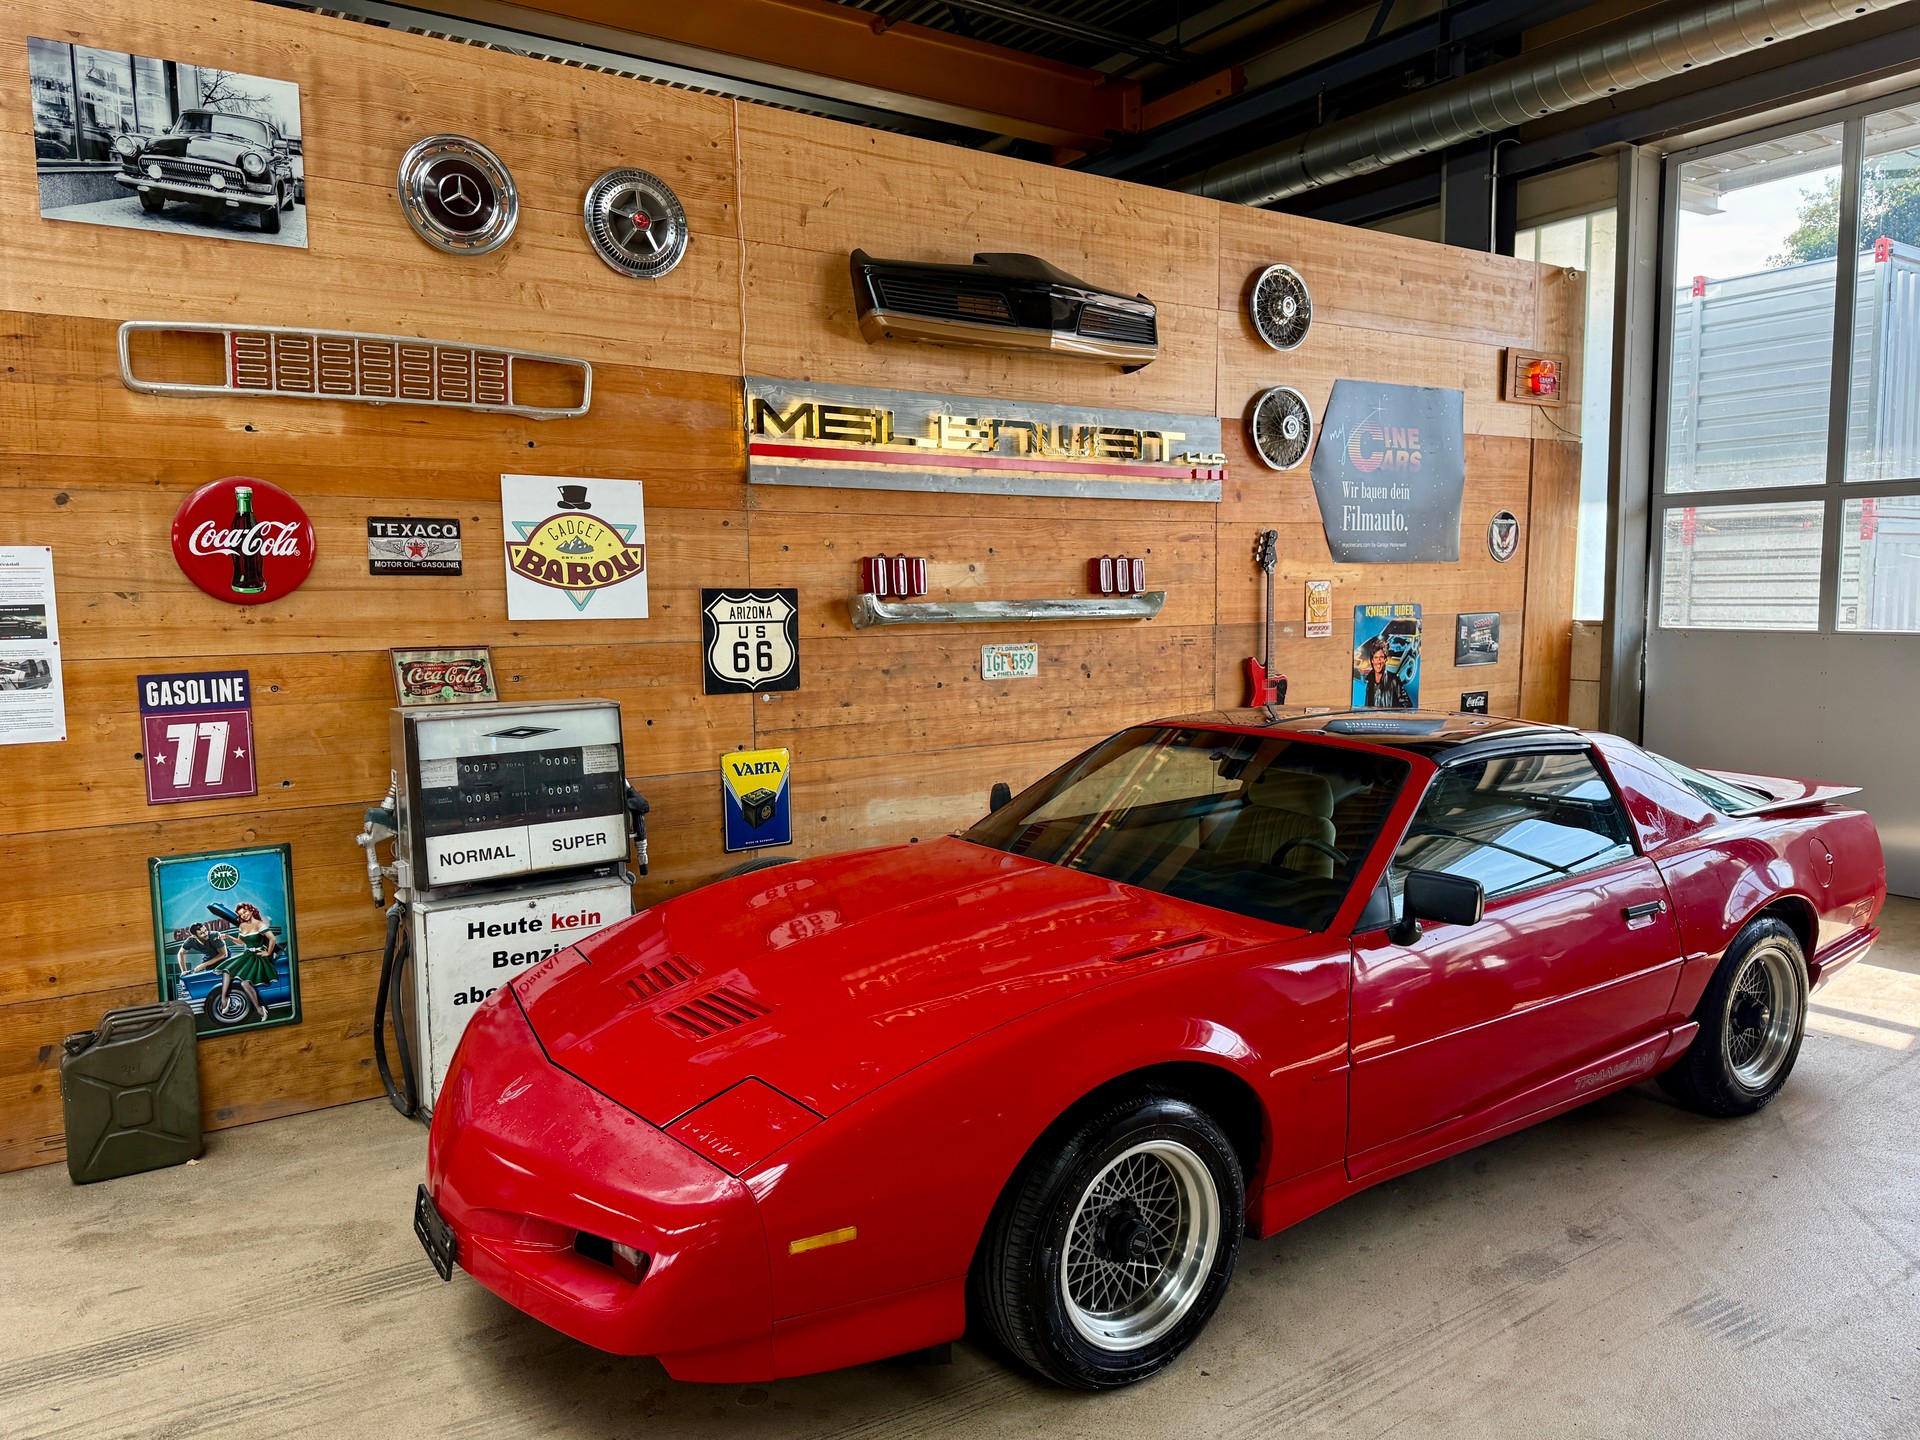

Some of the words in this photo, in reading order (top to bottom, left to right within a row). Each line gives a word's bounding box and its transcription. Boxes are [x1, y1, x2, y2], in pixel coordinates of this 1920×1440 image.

[752, 398, 1186, 462] MEILENWEIT
[1342, 480, 1359, 498] Wir
[1361, 481, 1388, 499] bauen
[1390, 482, 1410, 500] dein
[372, 522, 458, 537] TEXACO
[1342, 505, 1408, 532] Filmauto.
[189, 520, 301, 556] Coca-Cola
[547, 520, 605, 542] GADGET
[516, 547, 640, 585] BARON
[1311, 596, 1328, 604] SHELL
[1365, 605, 1392, 617] KNIGHT
[729, 606, 773, 619] ARIZONA
[733, 640, 773, 673] 66
[408, 665, 483, 685] Coca-Cola
[145, 677, 245, 707] GASOLINE
[732, 761, 782, 776] VARTA
[552, 832, 607, 852] SUPER
[439, 845, 516, 867] NORMAL
[467, 917, 543, 940] Heute
[551, 910, 601, 930] kein
[492, 943, 571, 969] Benzi
